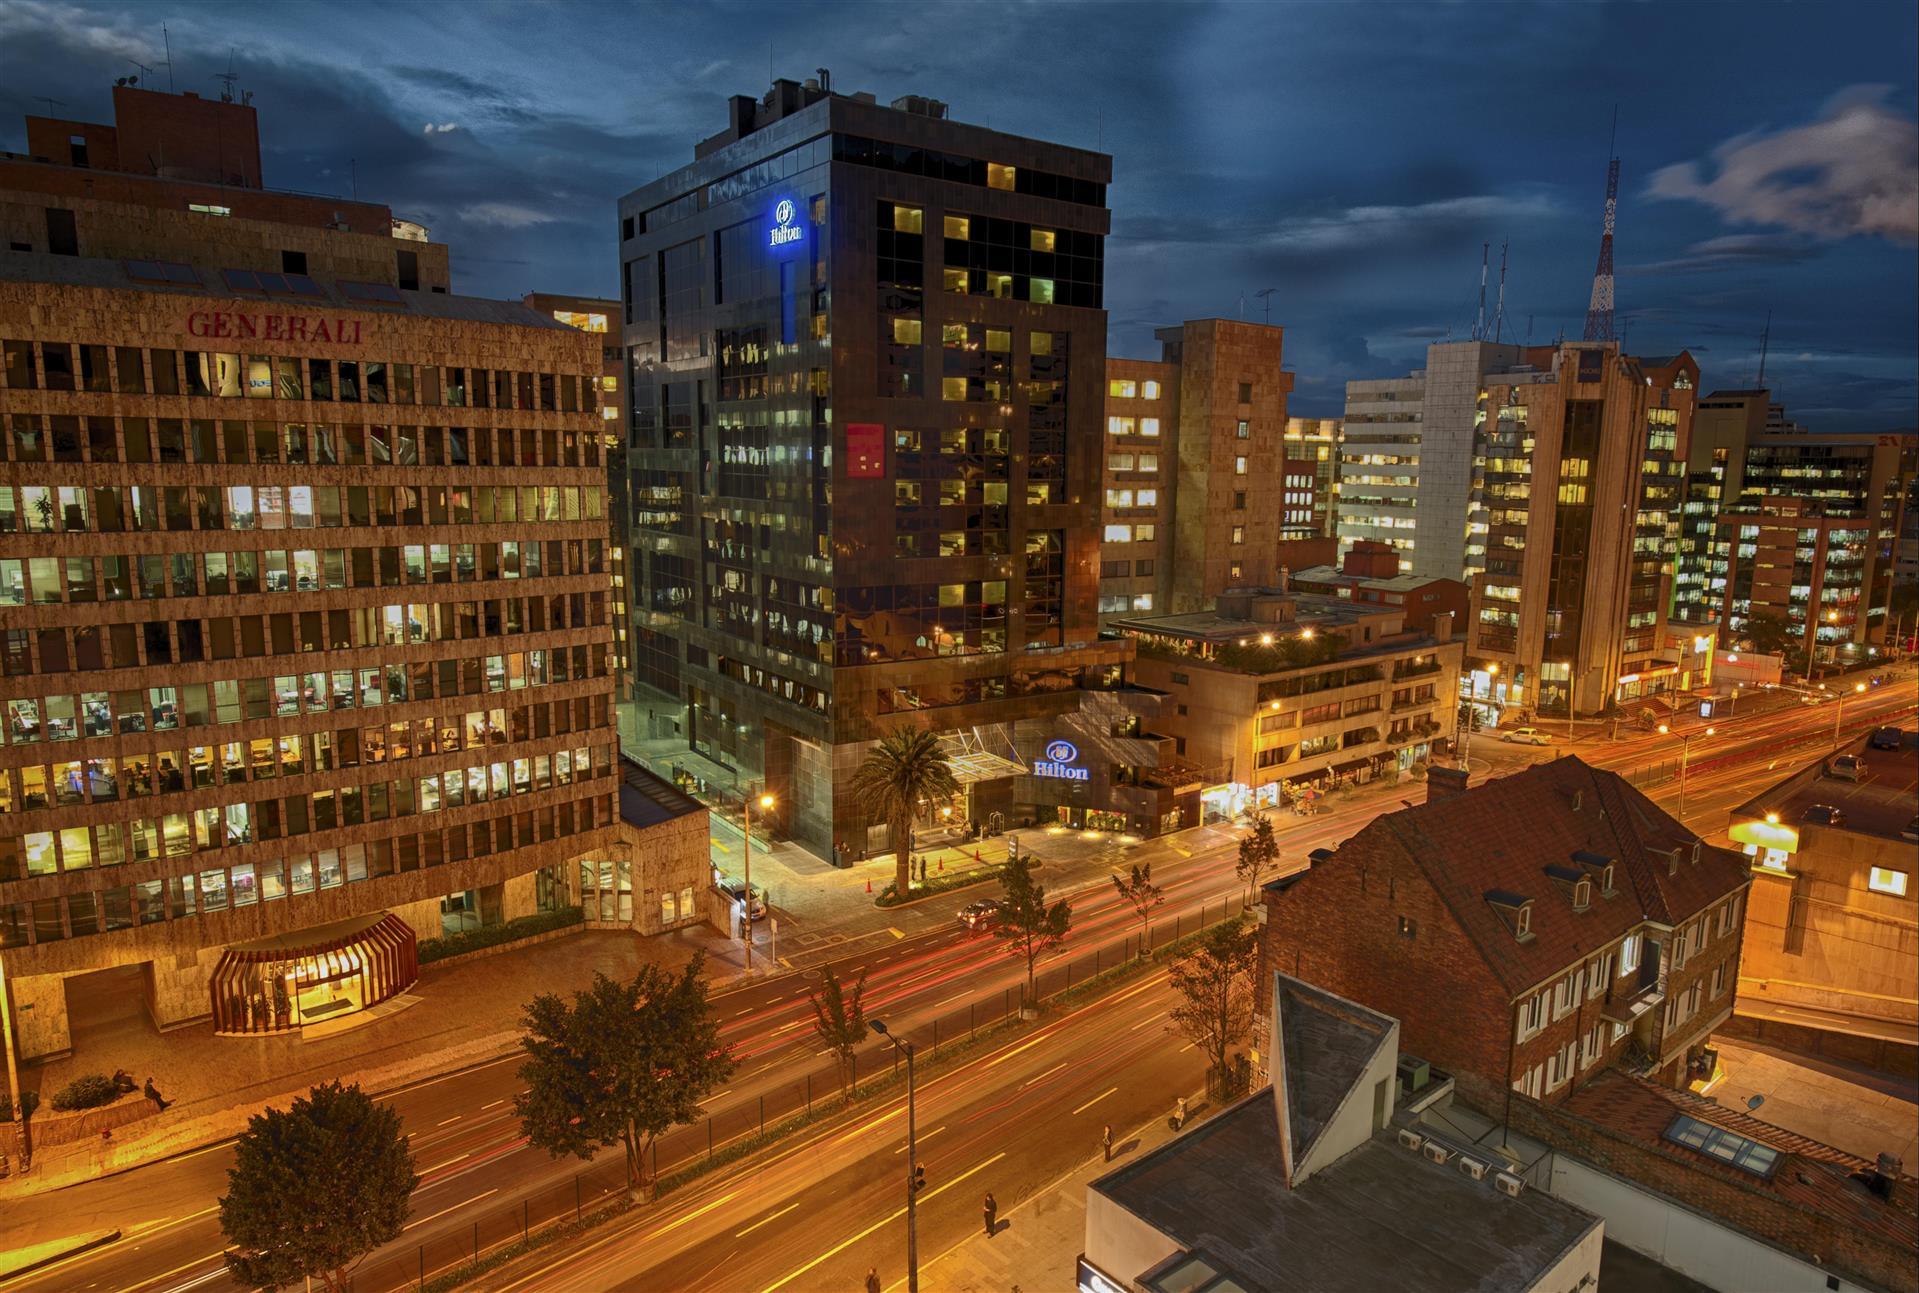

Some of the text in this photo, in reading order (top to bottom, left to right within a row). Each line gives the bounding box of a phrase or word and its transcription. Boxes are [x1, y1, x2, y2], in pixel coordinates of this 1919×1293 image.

[770, 225, 803, 246] Hilton
[188, 311, 363, 344] GENERALI
[1033, 761, 1089, 780] Hilton
